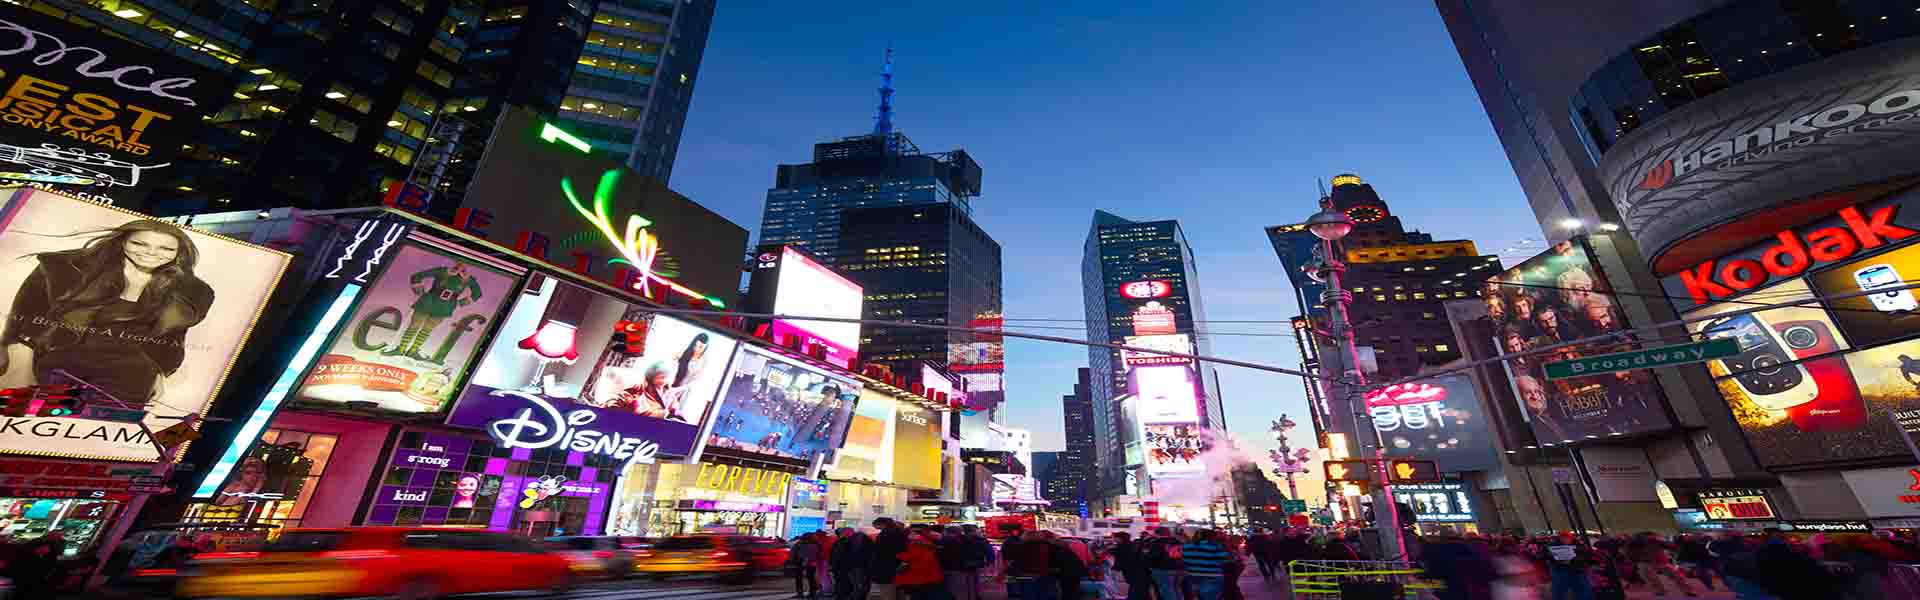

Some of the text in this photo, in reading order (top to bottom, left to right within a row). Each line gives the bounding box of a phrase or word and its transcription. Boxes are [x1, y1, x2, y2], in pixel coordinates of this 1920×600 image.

[0, 69, 175, 132] EST
[61, 129, 150, 156] AWARD
[1679, 204, 1920, 306] Kodak
[758, 262, 777, 270] LG
[1127, 356, 1191, 365] TOSHIBA
[1570, 347, 1706, 373] Broadway
[0, 418, 155, 445] KGLAM
[431, 445, 443, 453] am
[407, 455, 451, 468] srong
[695, 461, 792, 496] FOREVER
[393, 489, 427, 502] kind
[1795, 521, 1869, 532] sunglass hut
